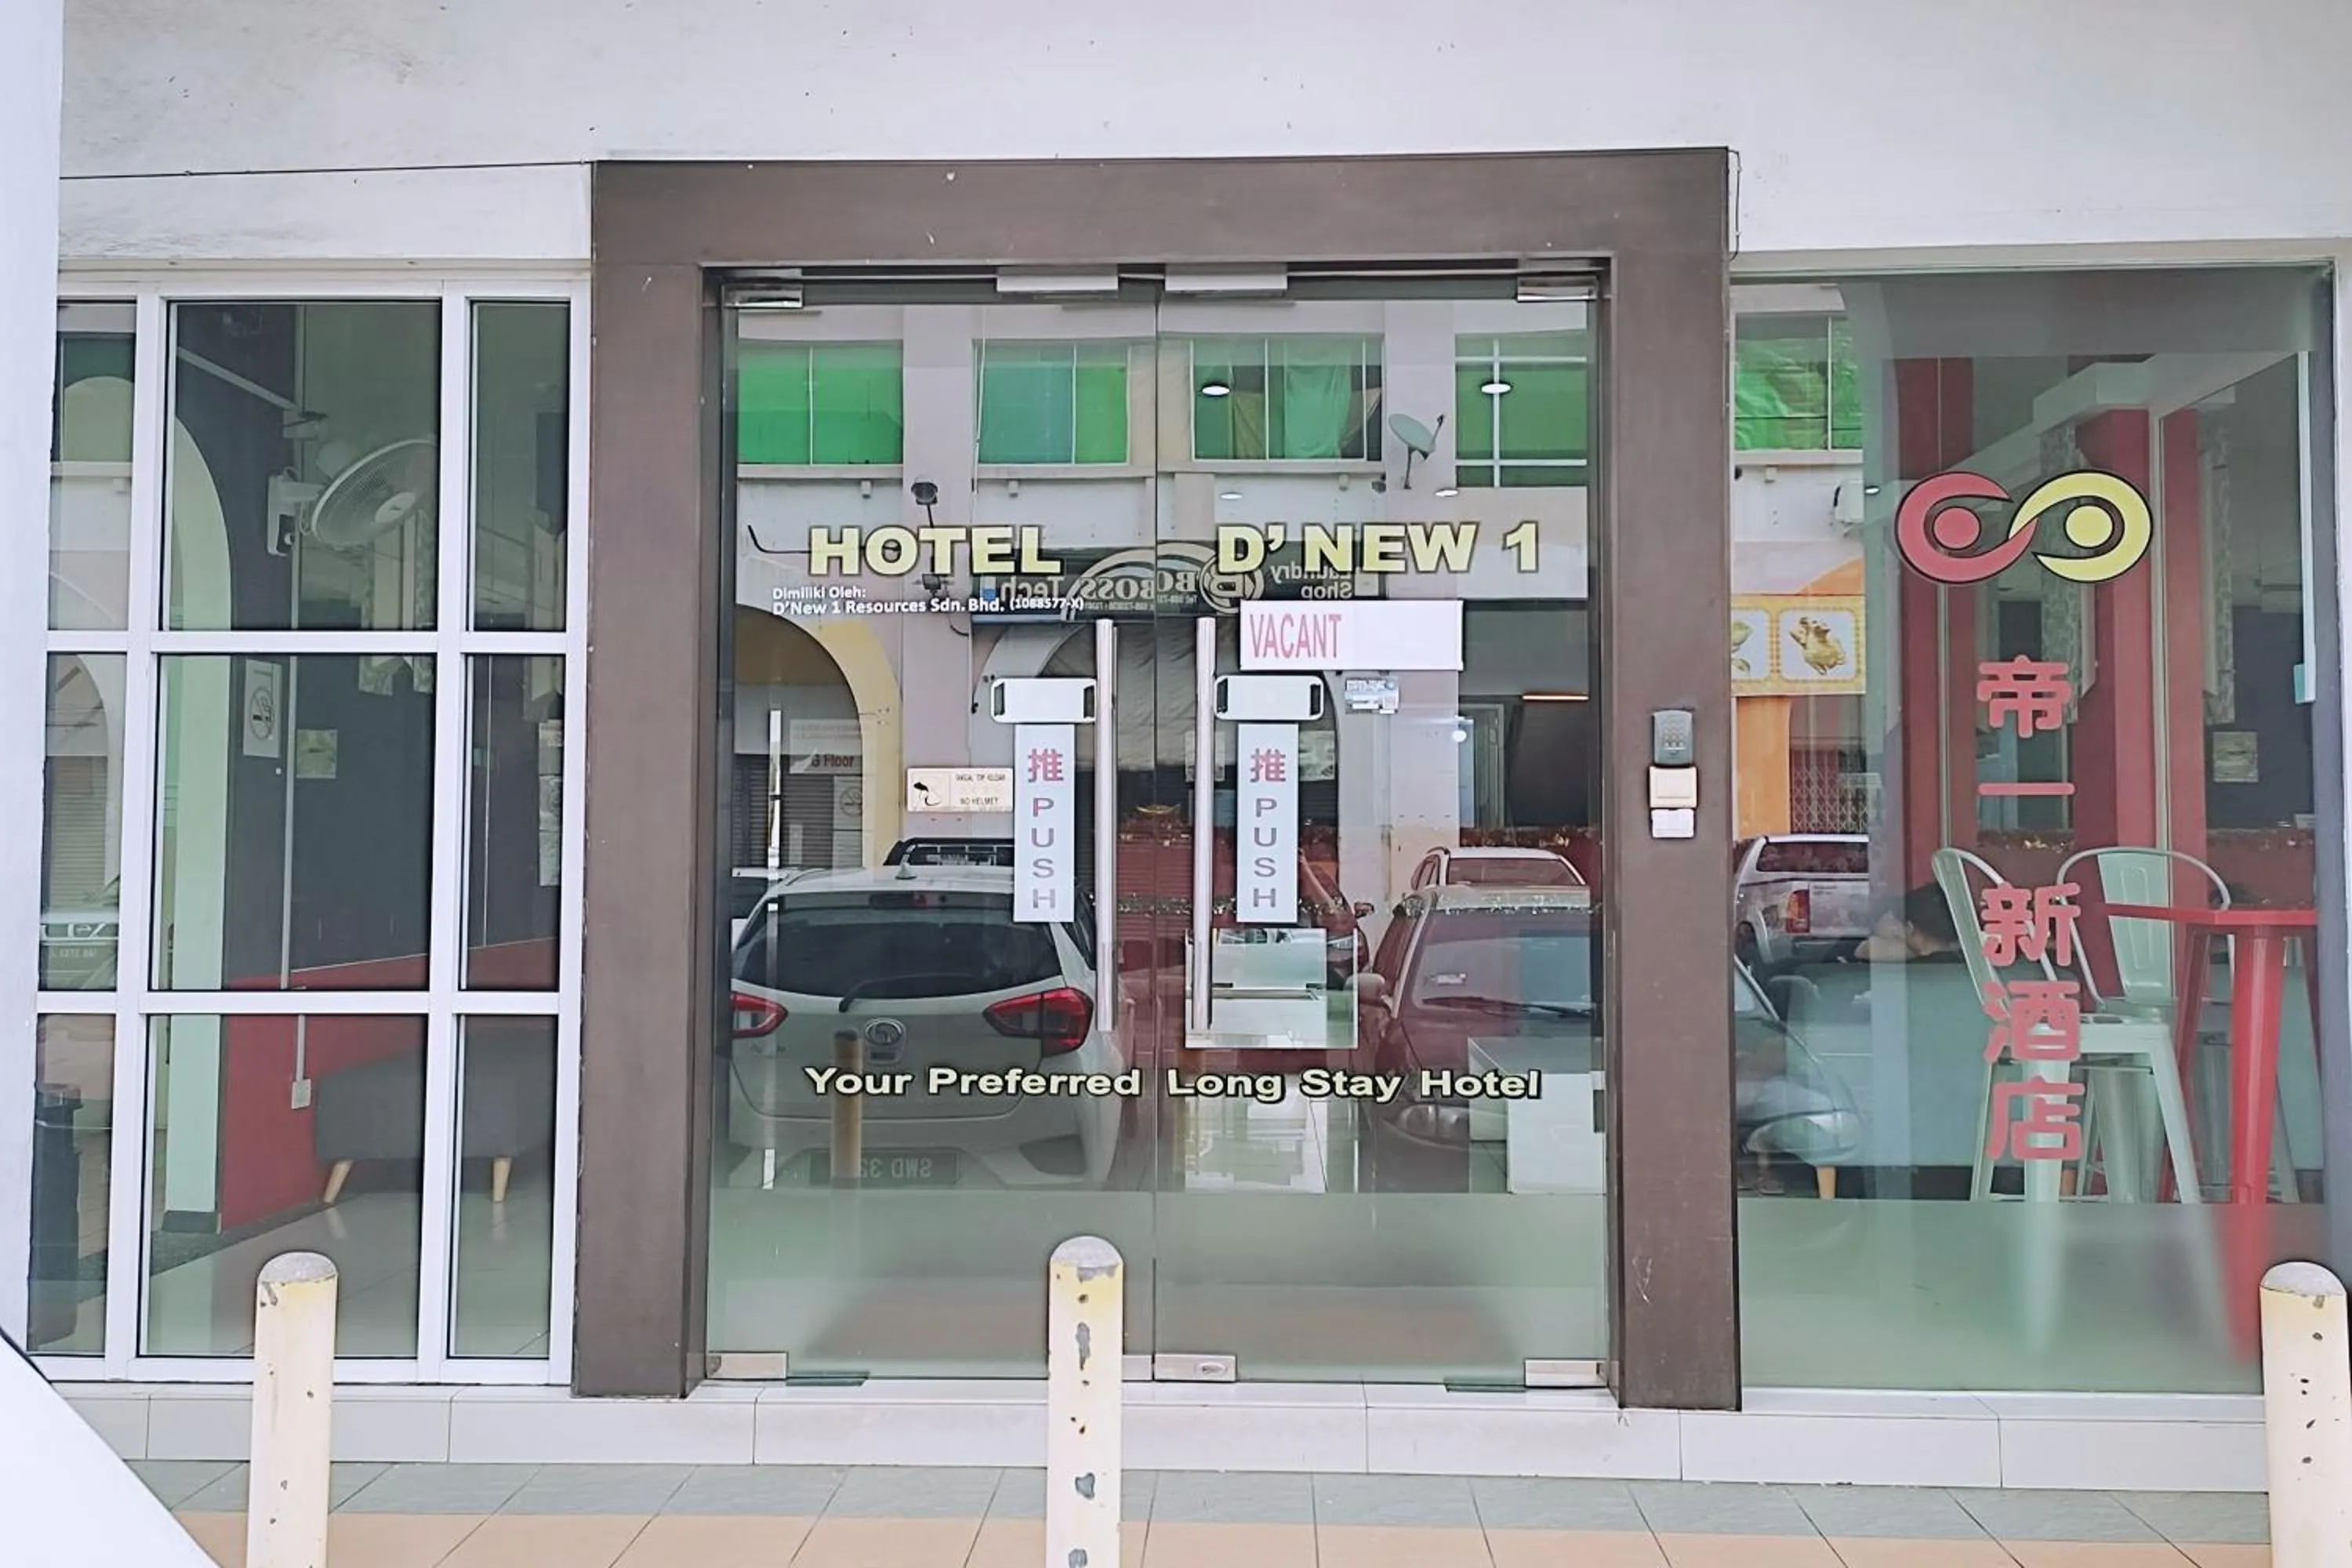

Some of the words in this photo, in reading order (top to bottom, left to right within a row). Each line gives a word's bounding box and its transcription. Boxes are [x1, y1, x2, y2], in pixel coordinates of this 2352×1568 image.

[808, 525, 1063, 577] HOTEL
[1504, 523, 1540, 573] 1
[772, 586, 826, 600] Dimiliki
[829, 586, 866, 599] Oleh:
[832, 600, 841, 614] 1
[846, 599, 926, 615] Resources
[930, 597, 966, 613] Sdn.
[968, 597, 1004, 613] Bhd.
[1249, 614, 1342, 659] VACANT
[823, 753, 855, 768] Floor
[1028, 747, 1065, 783] 推
[1250, 747, 1287, 783] 推
[1031, 797, 1058, 909] PUSH
[1252, 797, 1279, 909] PUSH
[1976, 654, 2085, 1160] 帝一新酒店
[804, 1065, 914, 1097] Your
[928, 1065, 1142, 1097] Preferred
[1167, 1068, 1286, 1102] Long
[1299, 1068, 1403, 1102] Stay
[1421, 1068, 1542, 1099] Hotel
